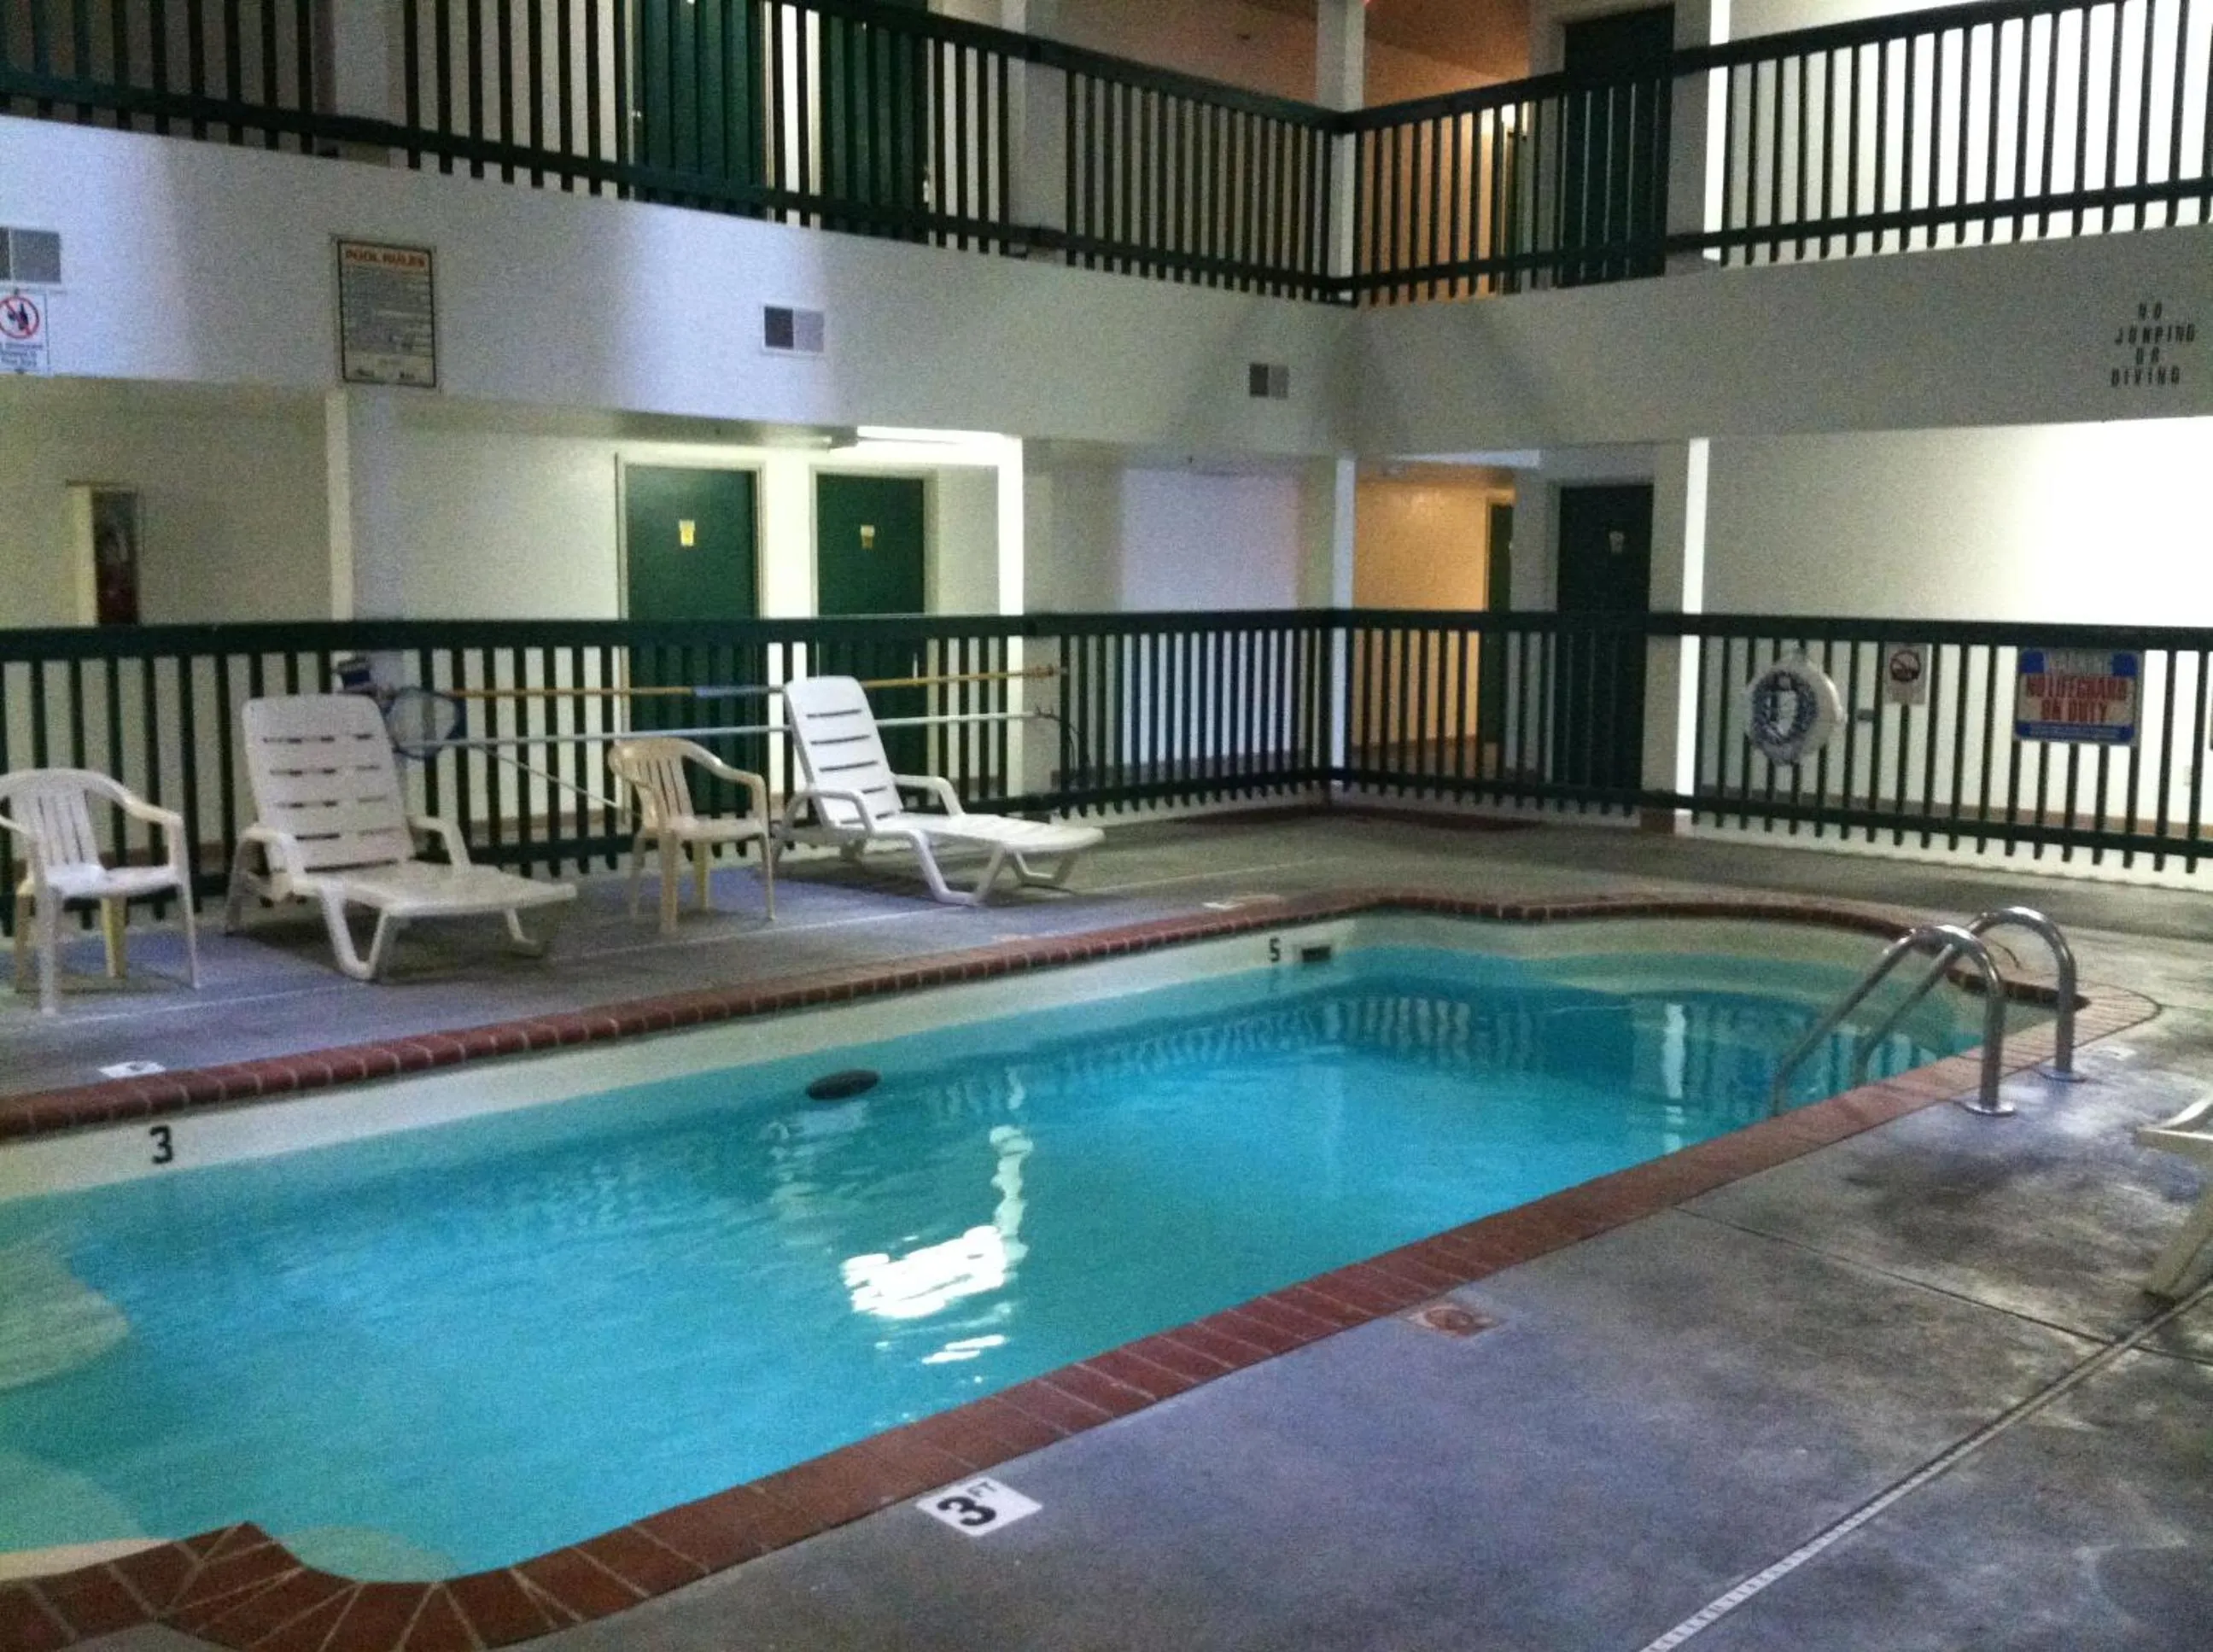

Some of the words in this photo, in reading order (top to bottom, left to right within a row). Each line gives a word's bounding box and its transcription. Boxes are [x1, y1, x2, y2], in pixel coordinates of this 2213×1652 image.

[345, 248, 377, 263] POOL
[2138, 302, 2163, 321] NO
[2114, 323, 2196, 346] JUMPING
[2135, 346, 2160, 365] OR
[2111, 365, 2181, 388] DIVING
[2027, 674, 2046, 698] NO
[2048, 675, 2128, 701] LIFEGUARD
[2041, 698, 2062, 721] ON
[2067, 699, 2107, 724] DUTY
[1269, 937, 1281, 962] 5
[149, 1125, 173, 1165] 3
[937, 1496, 997, 1526] 3
